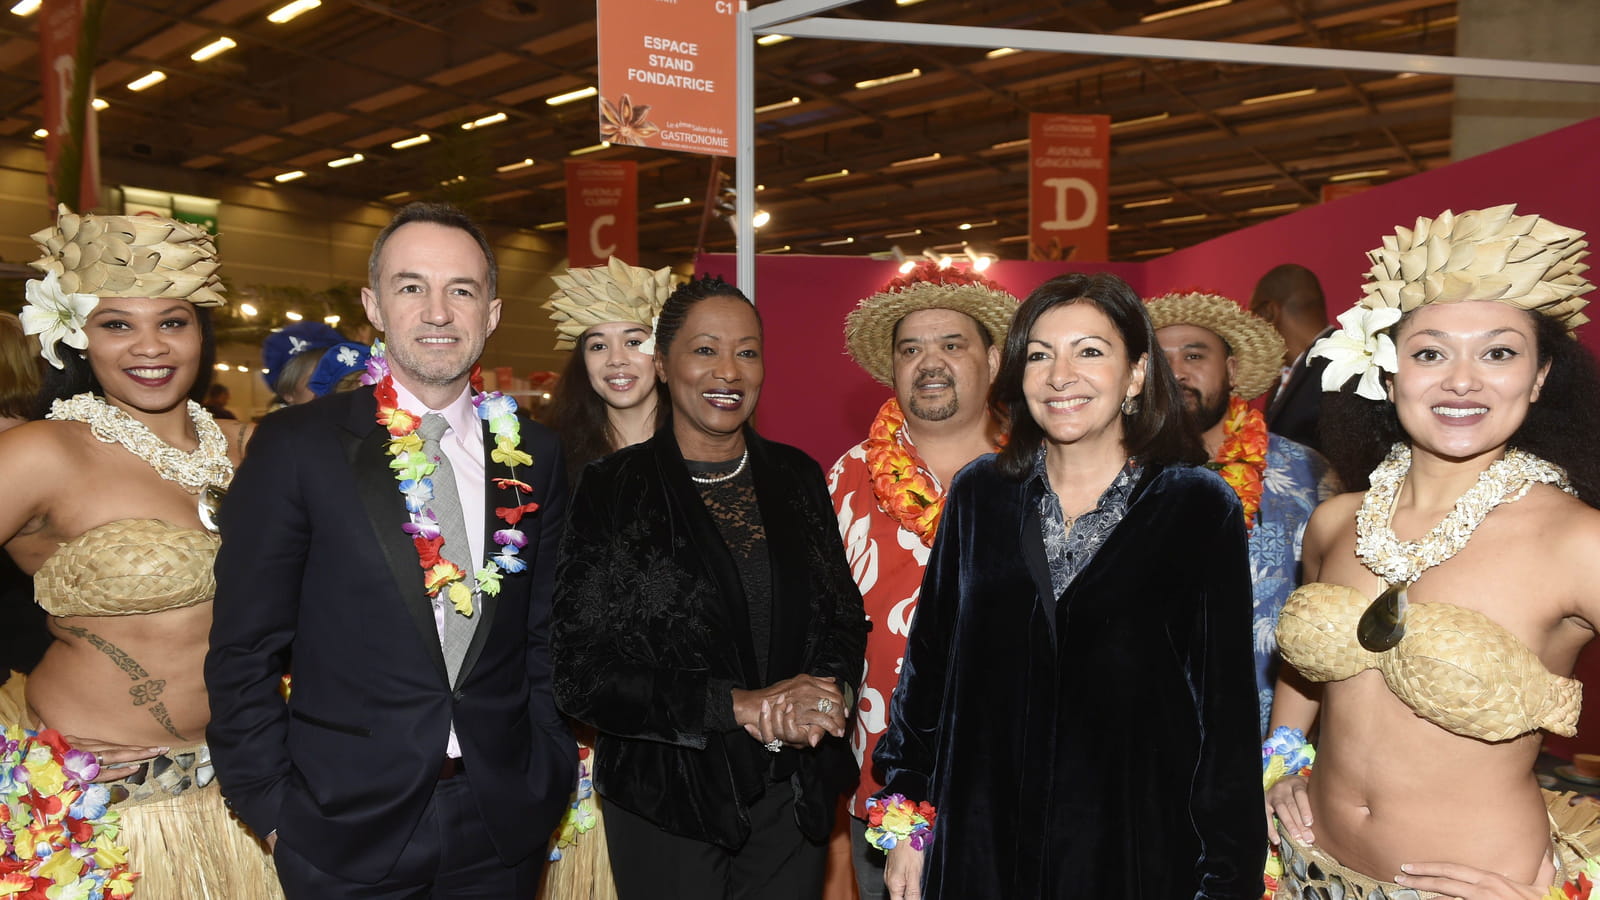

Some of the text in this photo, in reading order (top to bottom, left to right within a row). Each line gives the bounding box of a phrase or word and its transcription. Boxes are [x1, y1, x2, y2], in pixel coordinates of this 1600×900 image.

[715, 0, 732, 15] C1
[643, 35, 698, 56] ESPACE
[648, 54, 694, 72] STAND
[627, 68, 715, 93] FONDATRICE
[660, 130, 729, 147] GASTRONOMIE
[1040, 177, 1098, 230] D
[589, 213, 617, 259] C
